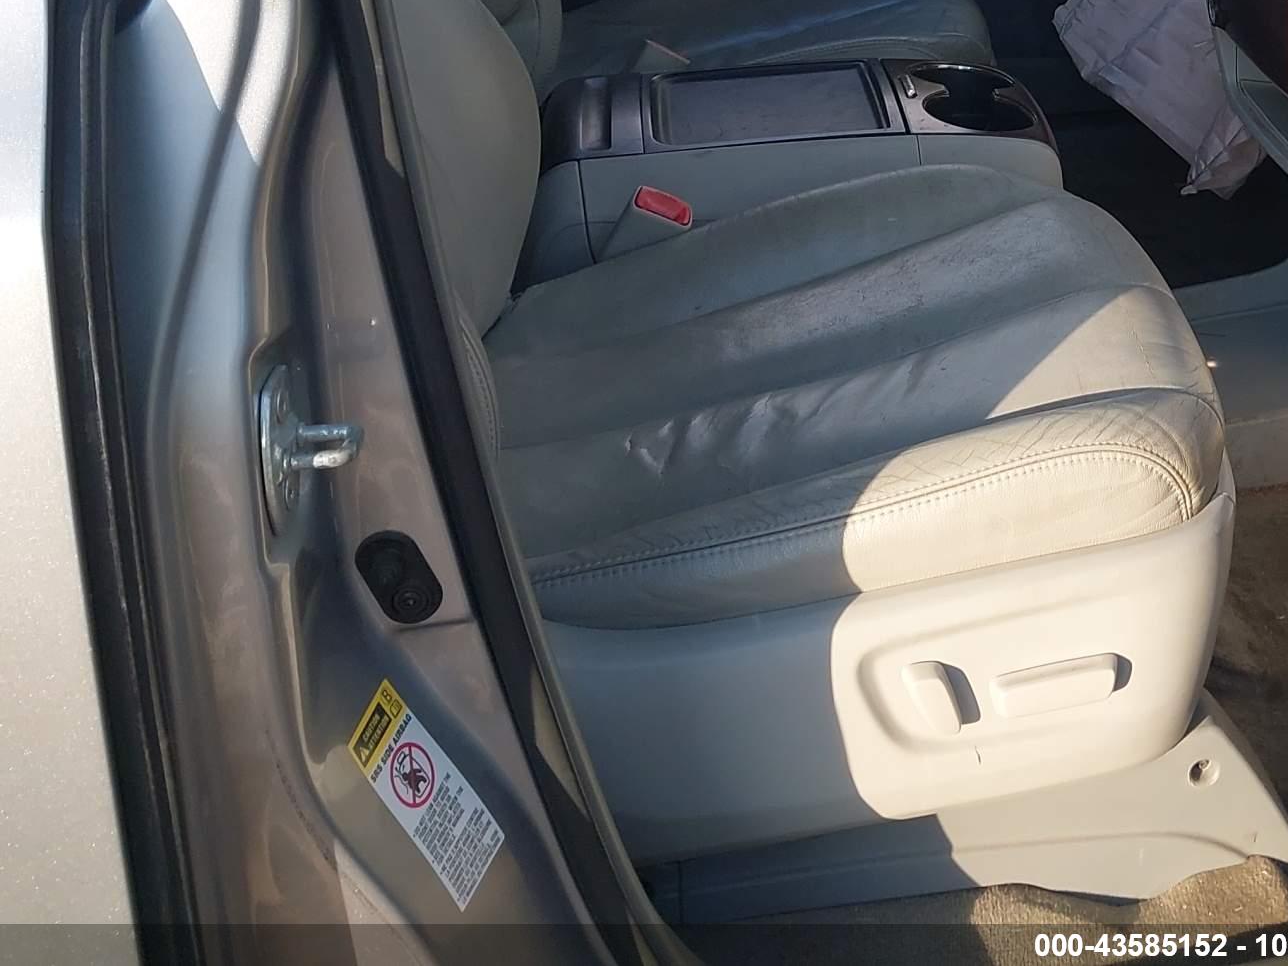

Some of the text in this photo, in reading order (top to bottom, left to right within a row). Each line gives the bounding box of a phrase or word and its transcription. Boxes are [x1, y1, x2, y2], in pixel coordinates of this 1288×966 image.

[370, 713, 412, 784] SRS SIDE AIRBAG
